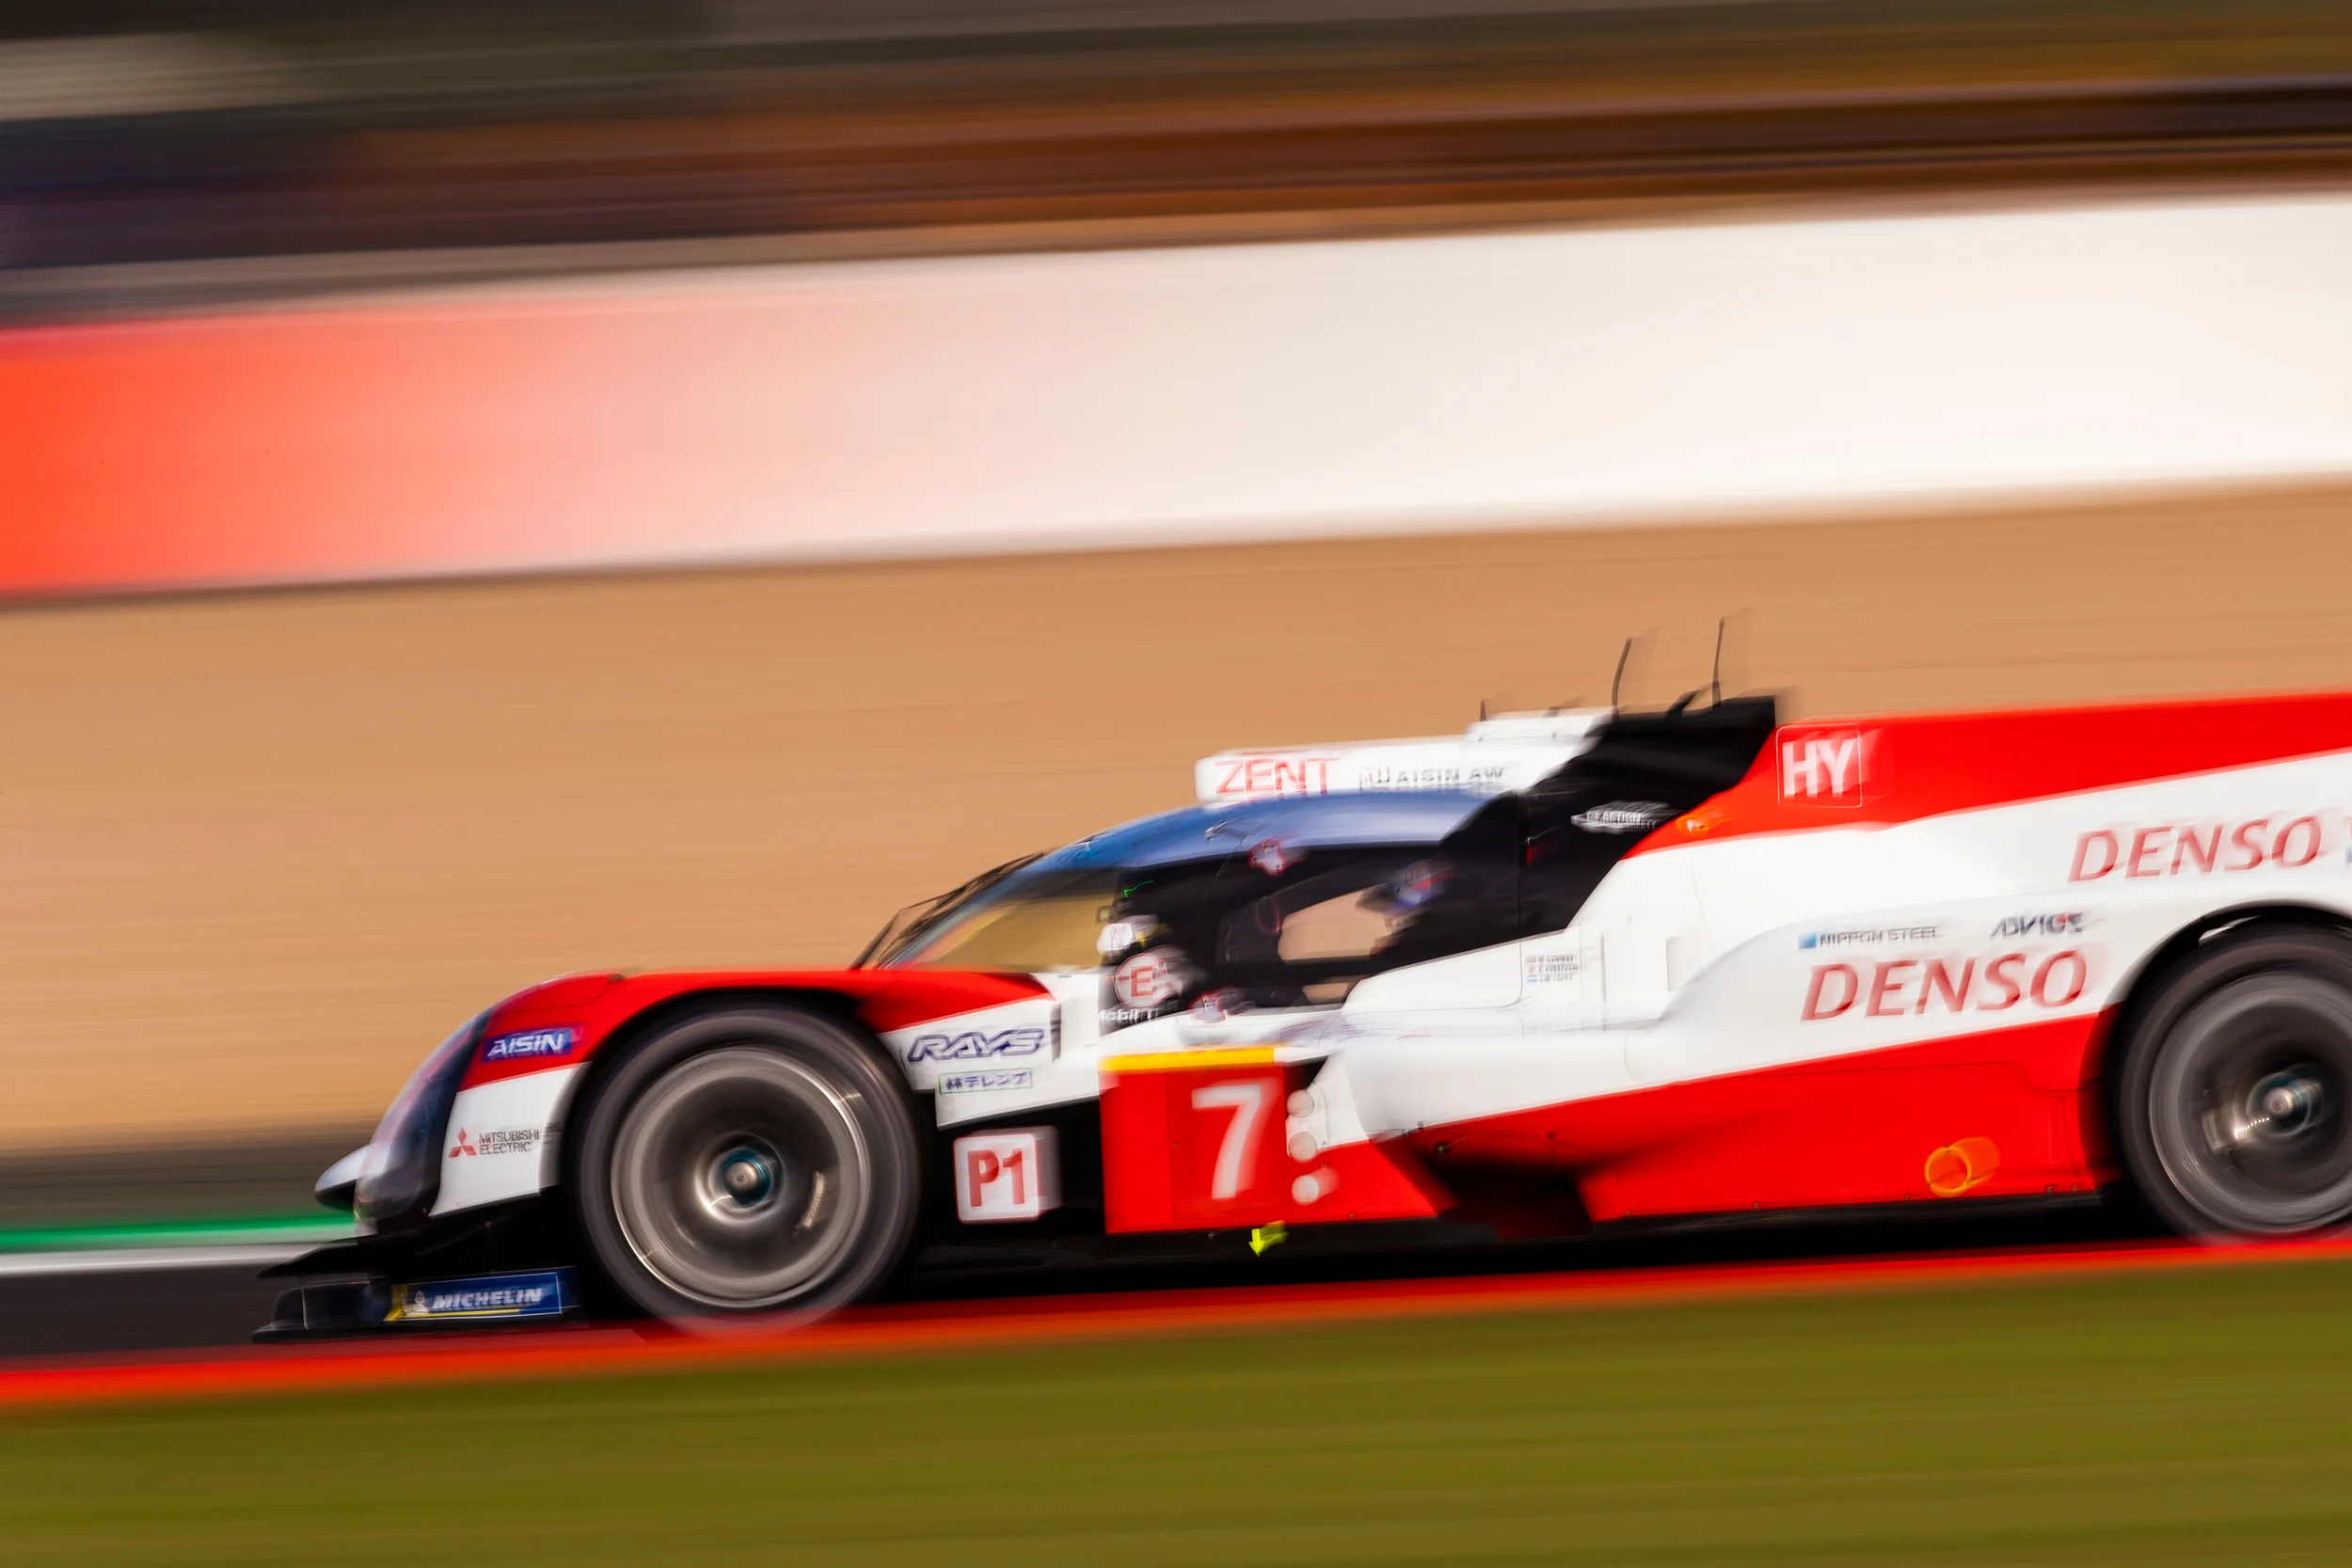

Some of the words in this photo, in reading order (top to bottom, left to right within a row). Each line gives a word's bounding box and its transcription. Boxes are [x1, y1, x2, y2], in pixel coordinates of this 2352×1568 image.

[1214, 755, 1340, 798] ZENT
[1396, 768, 1460, 789] AISIN
[1782, 737, 1857, 799] HY
[2068, 816, 2322, 884] DENSO
[1820, 929, 1883, 947] NIPPON
[1887, 925, 1939, 943] STEEL
[1801, 950, 2088, 1022] DENSO
[486, 1034, 564, 1057] AISIN
[907, 1028, 1044, 1062] RAYS
[479, 1130, 540, 1145] MITSUBISHI
[479, 1141, 532, 1155] ELECTRIC
[1191, 1084, 1263, 1201] 7
[966, 1148, 1026, 1208] P1
[432, 1288, 542, 1310] MICHELIN
